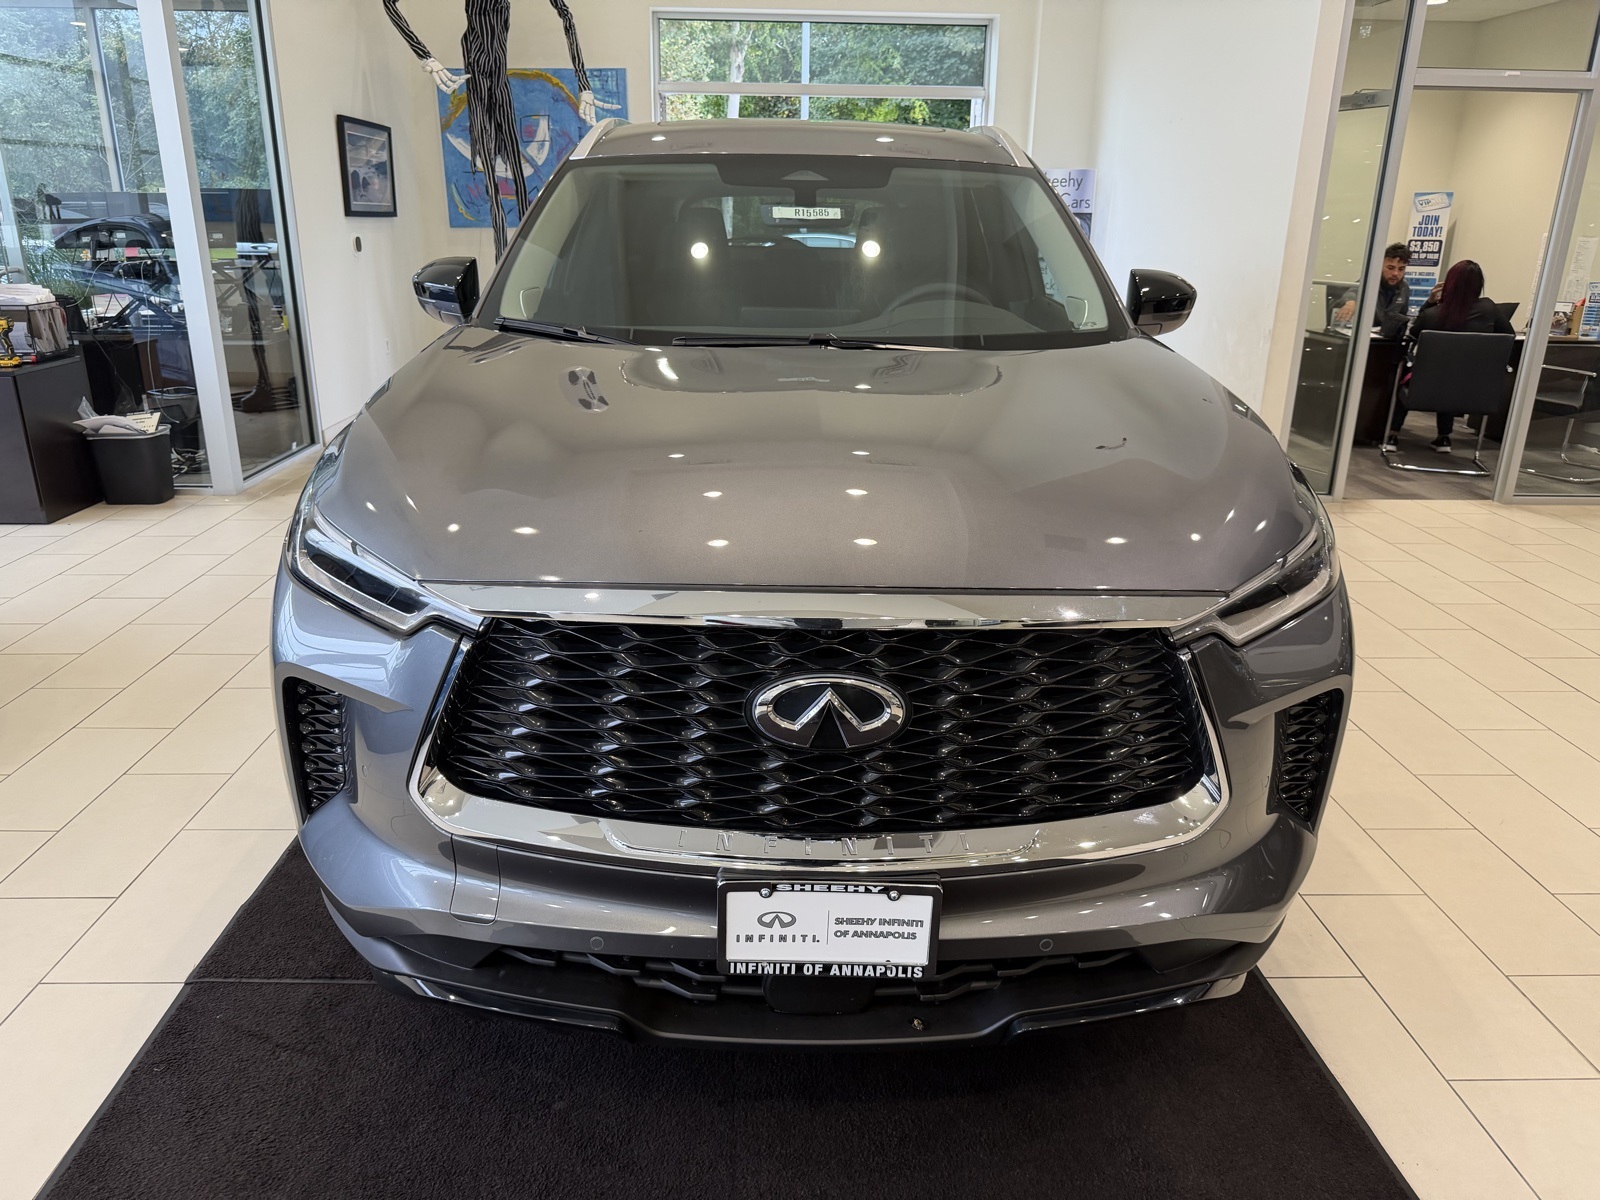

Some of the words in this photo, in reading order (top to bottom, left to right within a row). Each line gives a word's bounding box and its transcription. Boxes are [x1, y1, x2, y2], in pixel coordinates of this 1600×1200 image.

[1044, 171, 1083, 191] eehy
[794, 208, 830, 218] R15585
[1418, 215, 1440, 225] JOIN
[1412, 226, 1443, 237] TODAY!
[1409, 241, 1440, 253] $3,850
[678, 829, 971, 856] INFINITI
[776, 884, 885, 893] SHEEHY
[834, 917, 877, 926] SHEEHY
[878, 918, 924, 928] INFINITI
[833, 929, 850, 938] OF
[851, 930, 917, 940] ANNAPOLIS
[729, 962, 796, 975] INFINITI
[803, 963, 824, 976] OF
[830, 964, 924, 978] ANNAPOLIS
